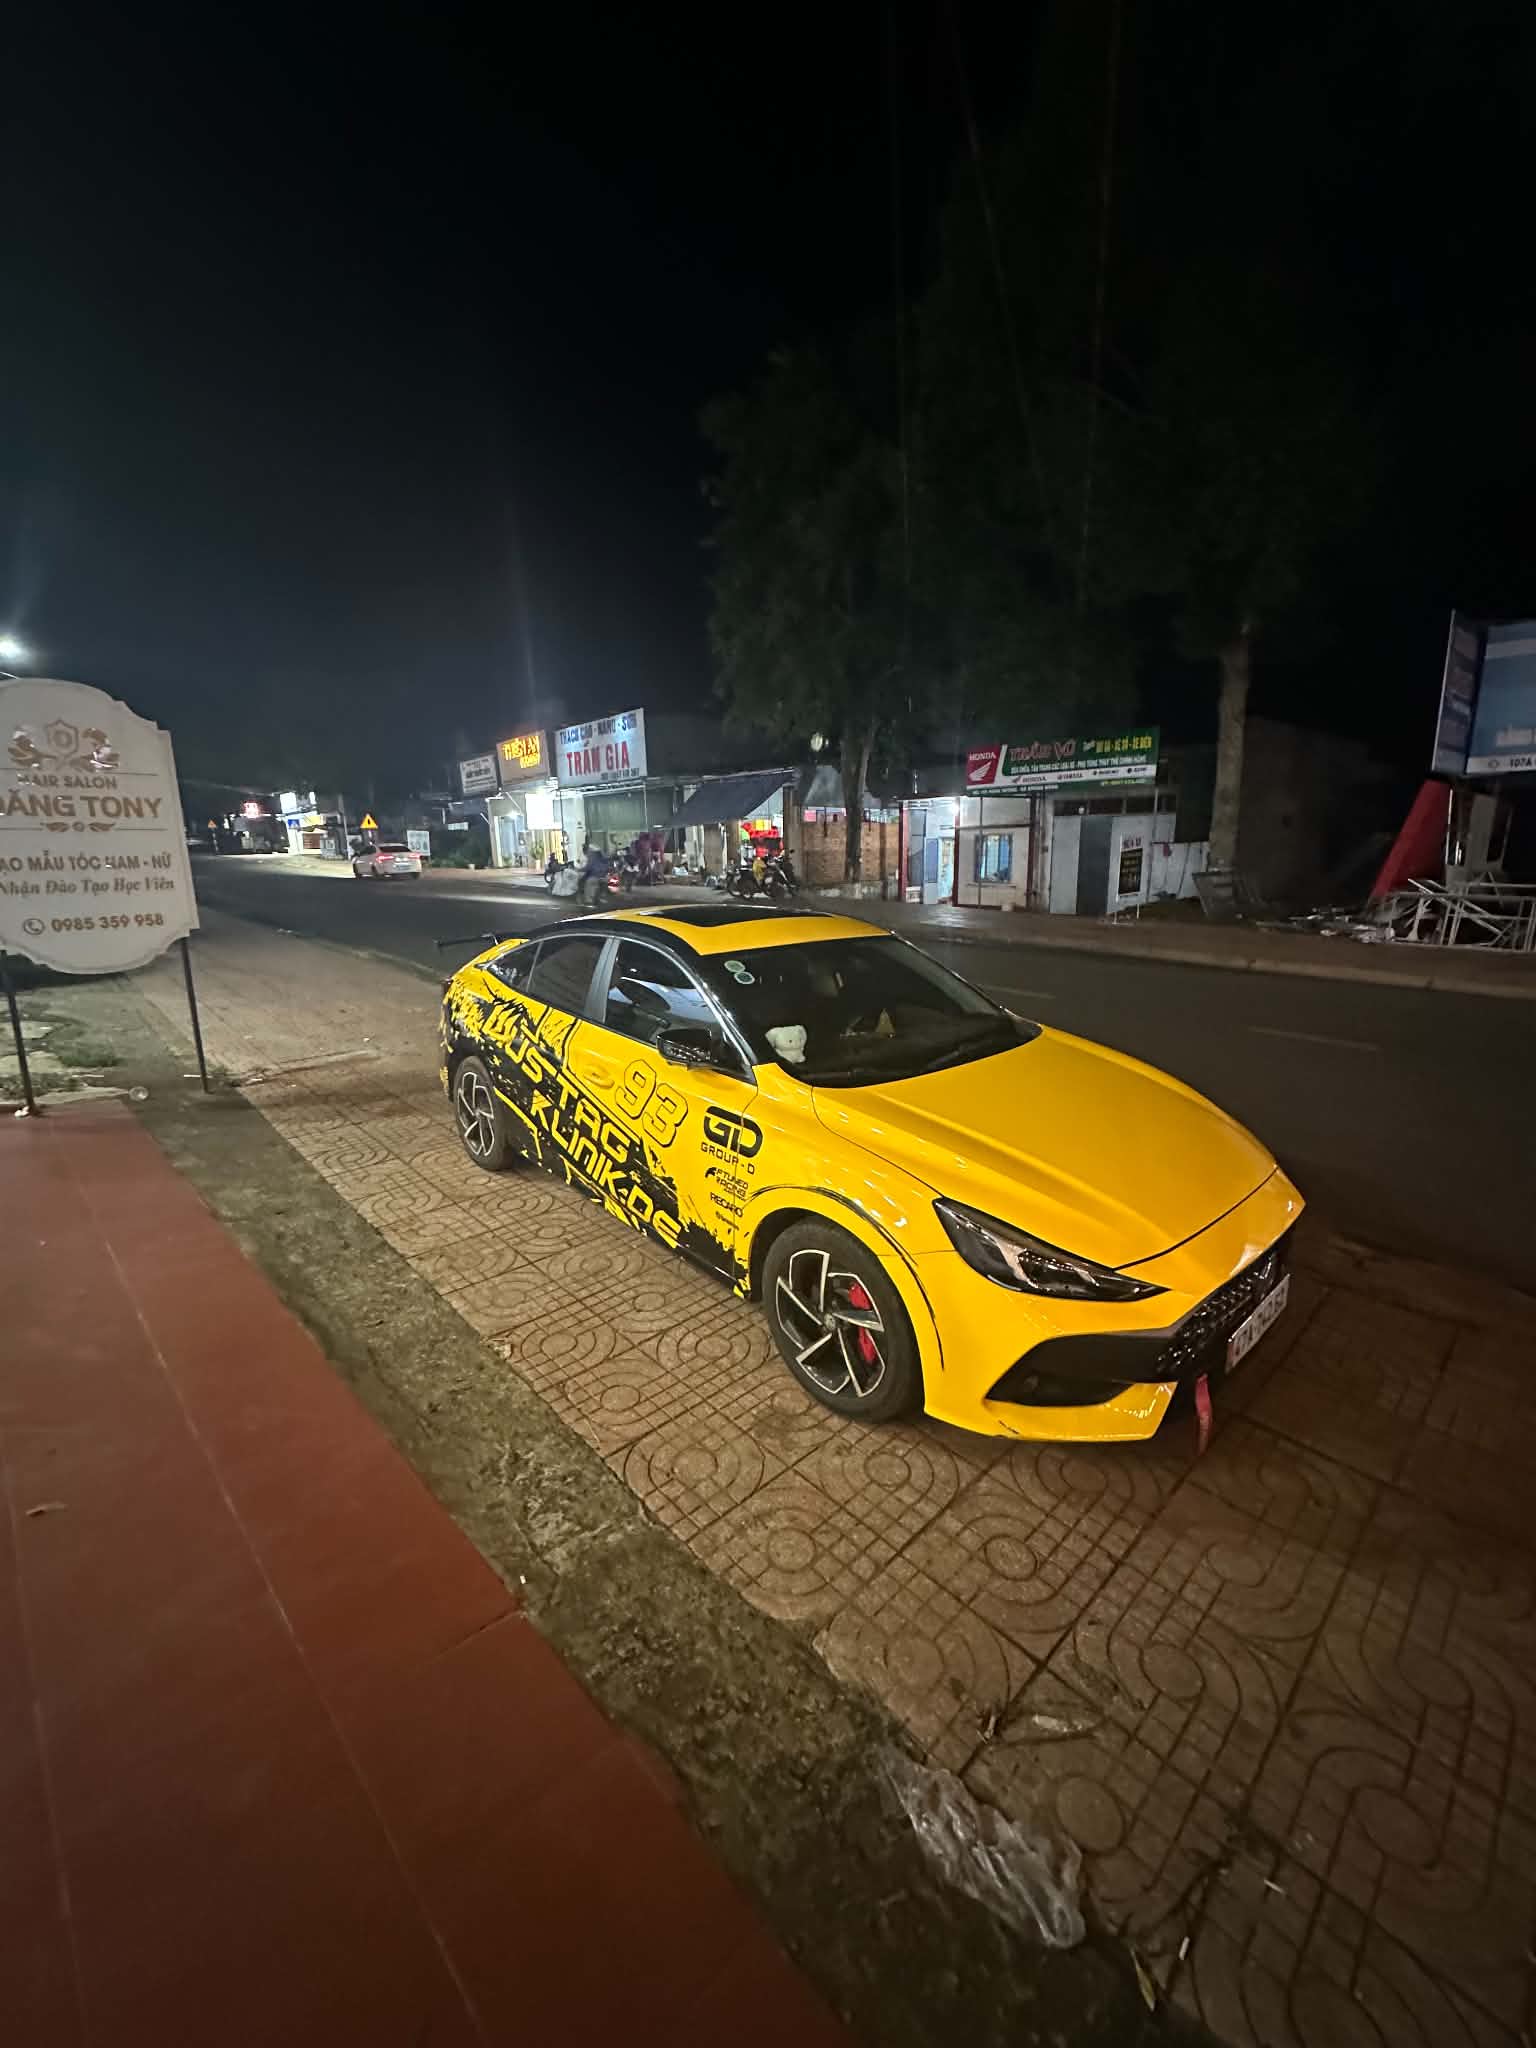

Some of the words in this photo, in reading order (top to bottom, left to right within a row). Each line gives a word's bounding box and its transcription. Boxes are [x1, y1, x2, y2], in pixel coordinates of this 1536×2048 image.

[605, 741, 630, 770] GIA
[969, 752, 997, 761] HONDA
[17, 774, 59, 788] HAIR
[64, 776, 118, 789] SALON
[80, 796, 163, 818] TONY
[68, 851, 102, 870] TÓC
[45, 879, 77, 894] Đào
[81, 879, 110, 896] Tạo
[113, 877, 142, 895] Học
[51, 918, 95, 932] 0985
[98, 915, 130, 929] 359
[133, 914, 164, 927] 958
[614, 1058, 689, 1148] 93
